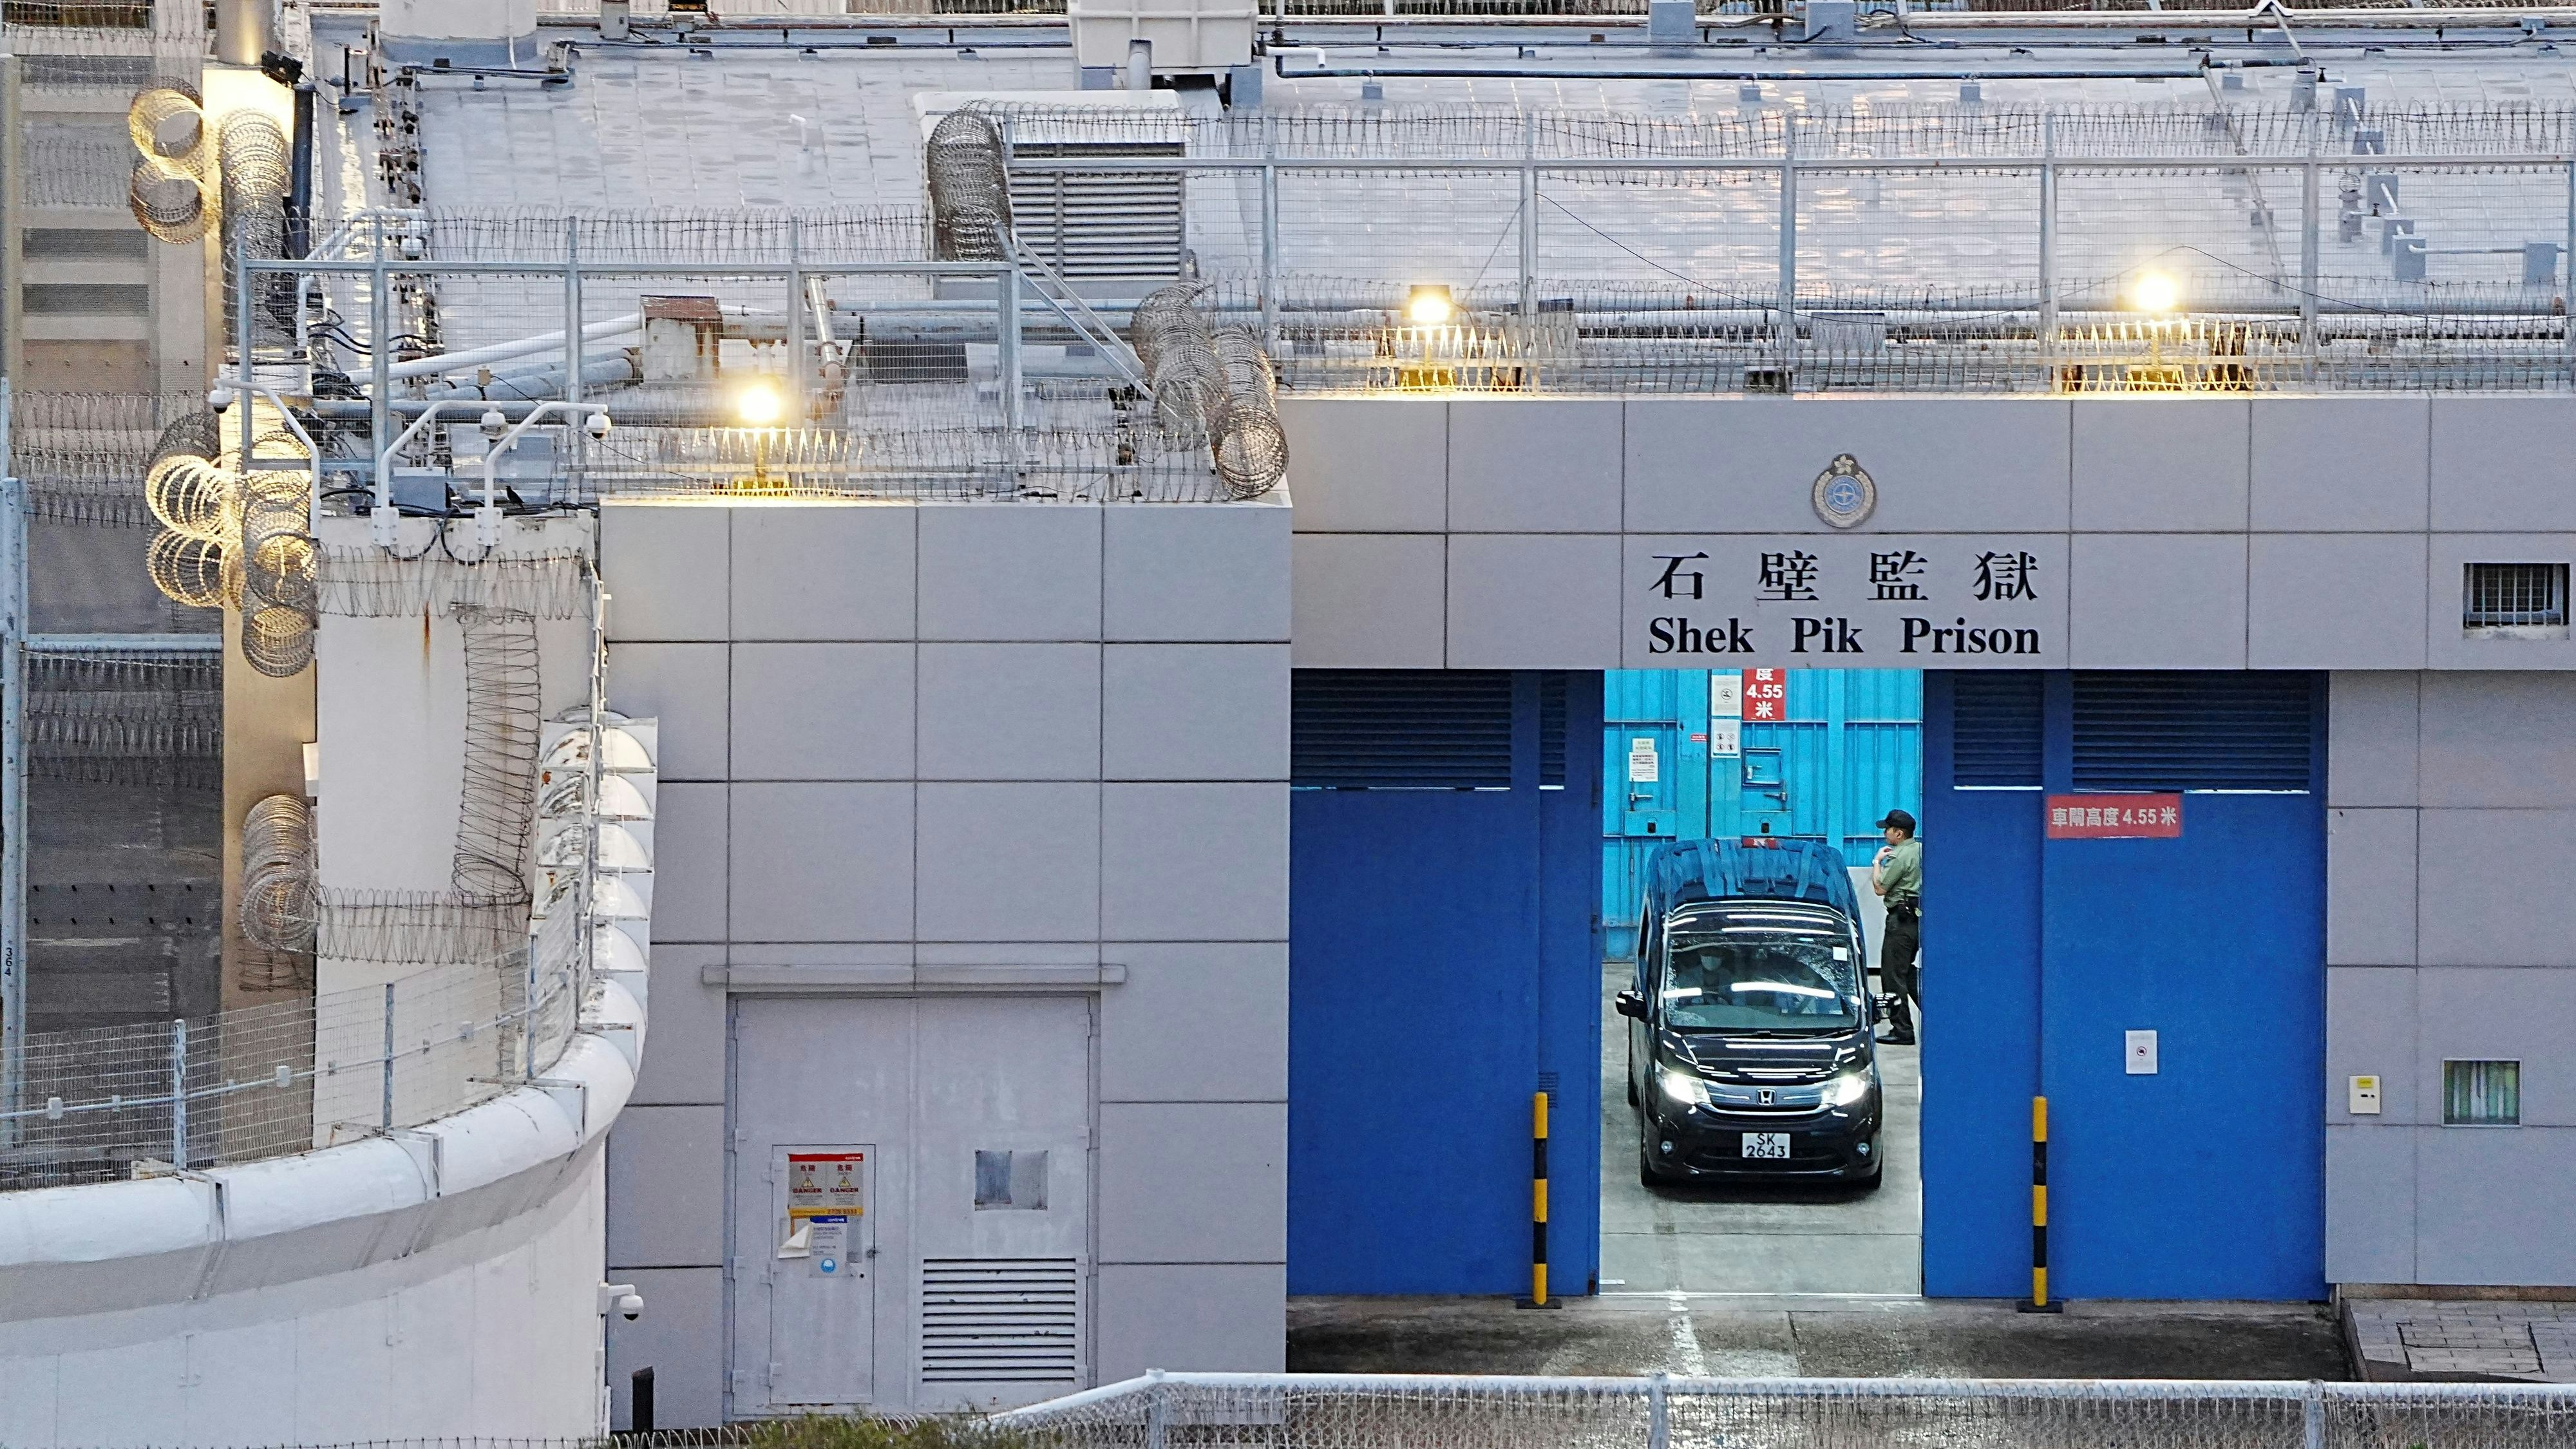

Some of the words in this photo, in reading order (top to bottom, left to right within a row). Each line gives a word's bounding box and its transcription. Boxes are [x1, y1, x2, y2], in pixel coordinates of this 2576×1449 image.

[1649, 549, 2038, 601] 石壁監獄
[1649, 616, 1755, 654] Shek
[1791, 616, 1864, 653] Pik
[1900, 616, 2040, 654] Prison
[1747, 684, 1783, 699] 4.55
[1755, 701, 1773, 718] 米
[2123, 808, 2156, 825] 4.55
[2161, 806, 2176, 826] 米
[5, 947, 13, 977] 364
[1757, 1133, 1776, 1145] SK
[1746, 1145, 1786, 1158] 2643
